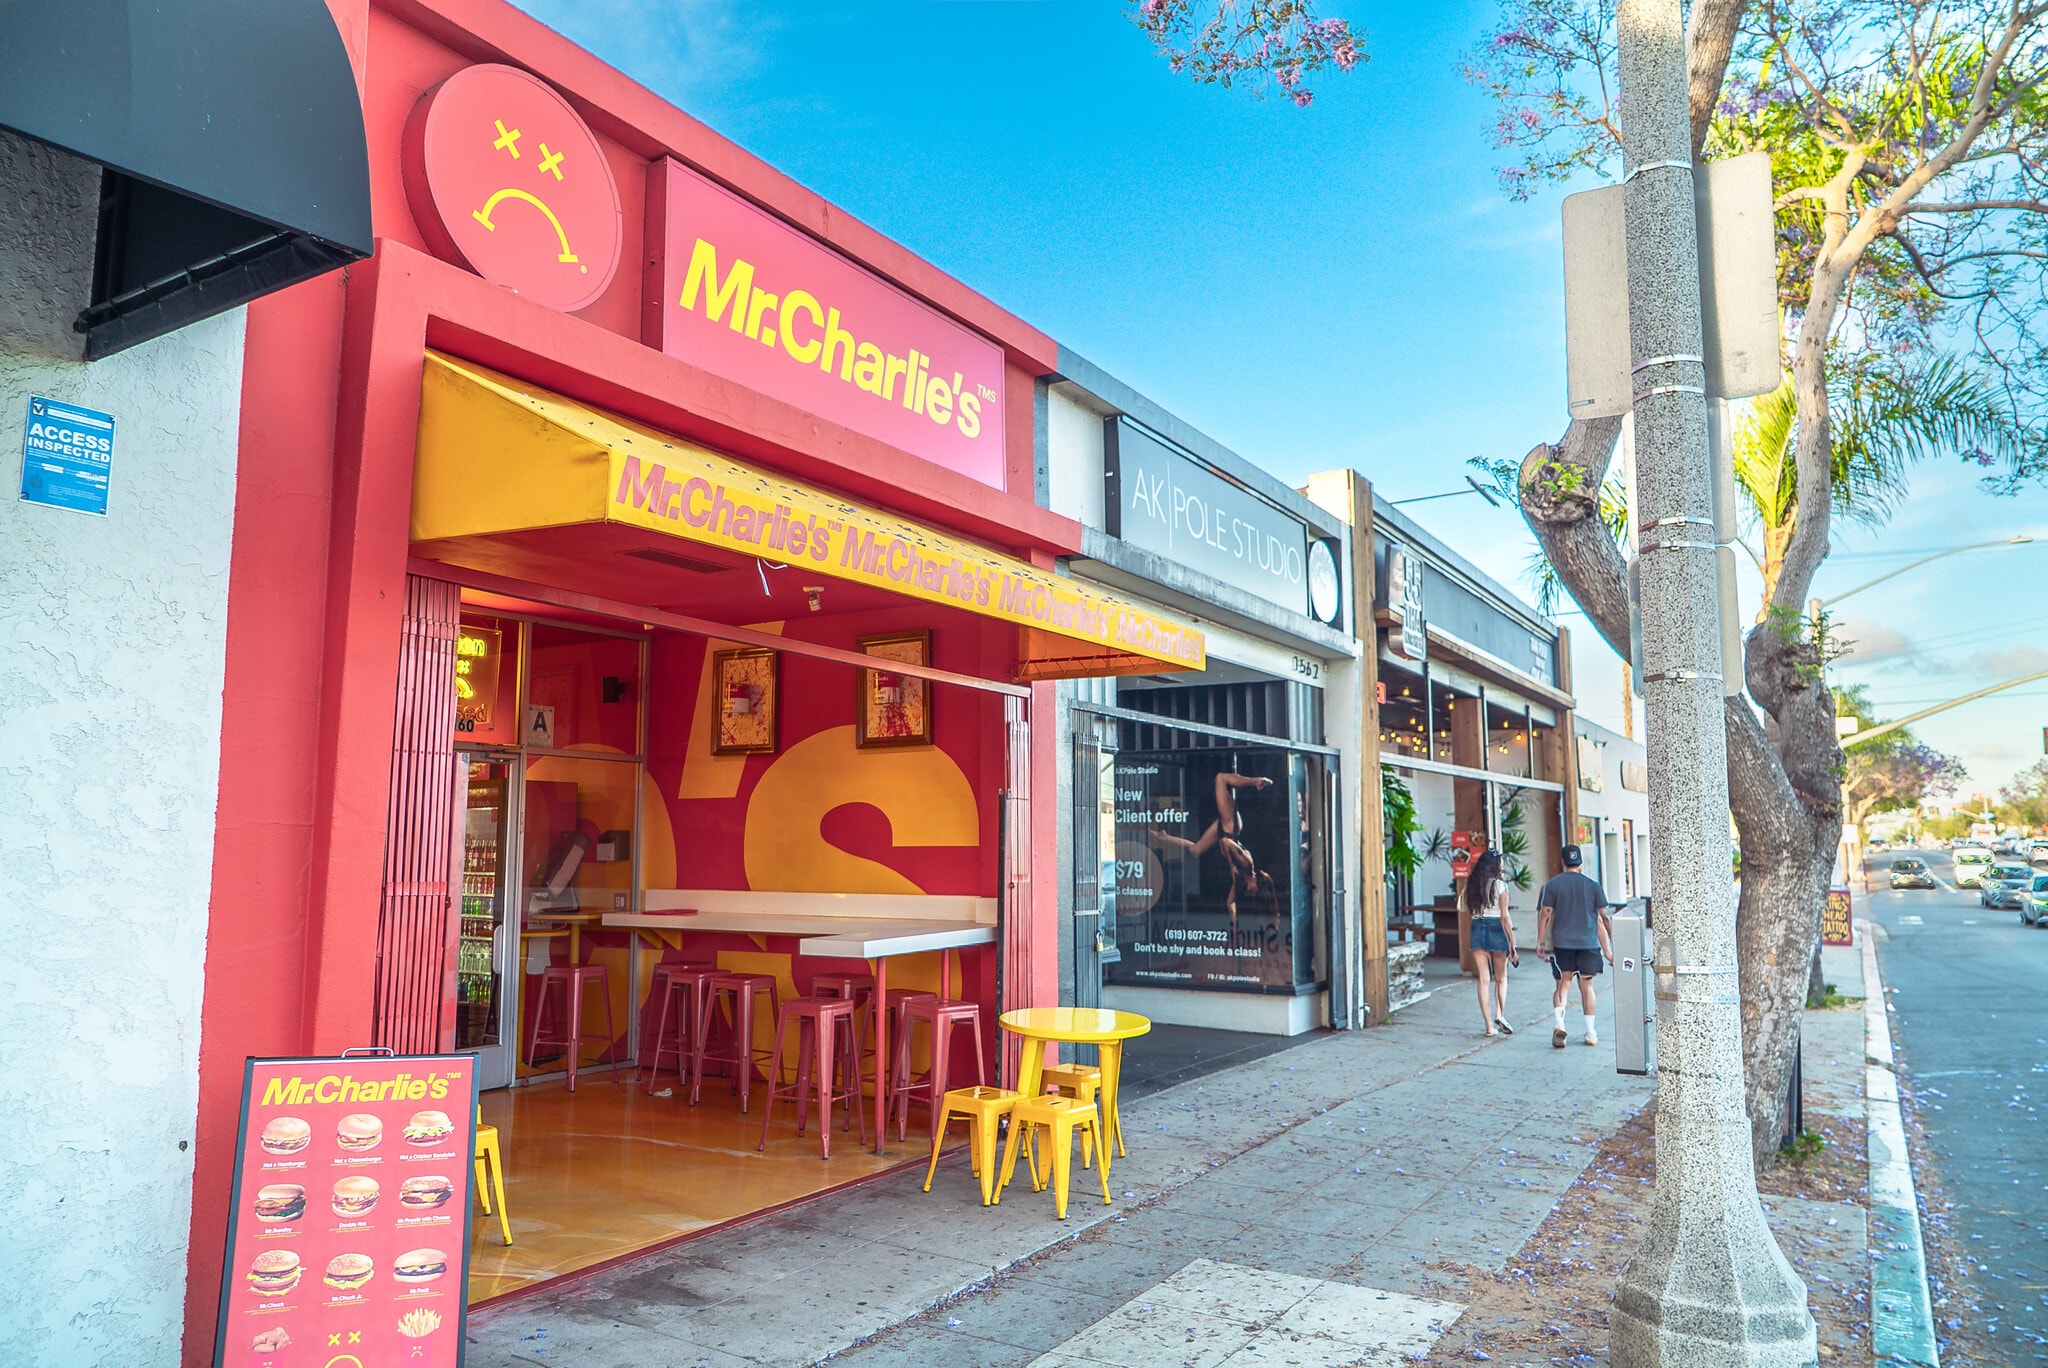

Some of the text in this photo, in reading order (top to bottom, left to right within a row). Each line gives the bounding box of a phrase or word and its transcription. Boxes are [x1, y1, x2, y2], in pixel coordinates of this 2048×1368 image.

[679, 237, 982, 438] Mr.Charlie's
[29, 422, 110, 452] ACCESS
[28, 436, 111, 463] INSPECTED
[615, 455, 831, 562] Mr.Charlie's
[840, 525, 991, 606] Mr.Charlie's
[1132, 467, 1301, 584] AK POLE STUDIO
[533, 711, 547, 732] A
[1137, 765, 1159, 774] Studio
[1115, 787, 1143, 802] New
[1115, 808, 1190, 824] Client offer
[1115, 858, 1145, 880] $79
[1121, 886, 1154, 896] classes
[1164, 928, 1186, 941] (619)
[1187, 930, 1228, 941] 607-3722
[1134, 942, 1261, 957] Don't be shy and book a class!
[260, 1072, 450, 1106] Mr.Charlie's
